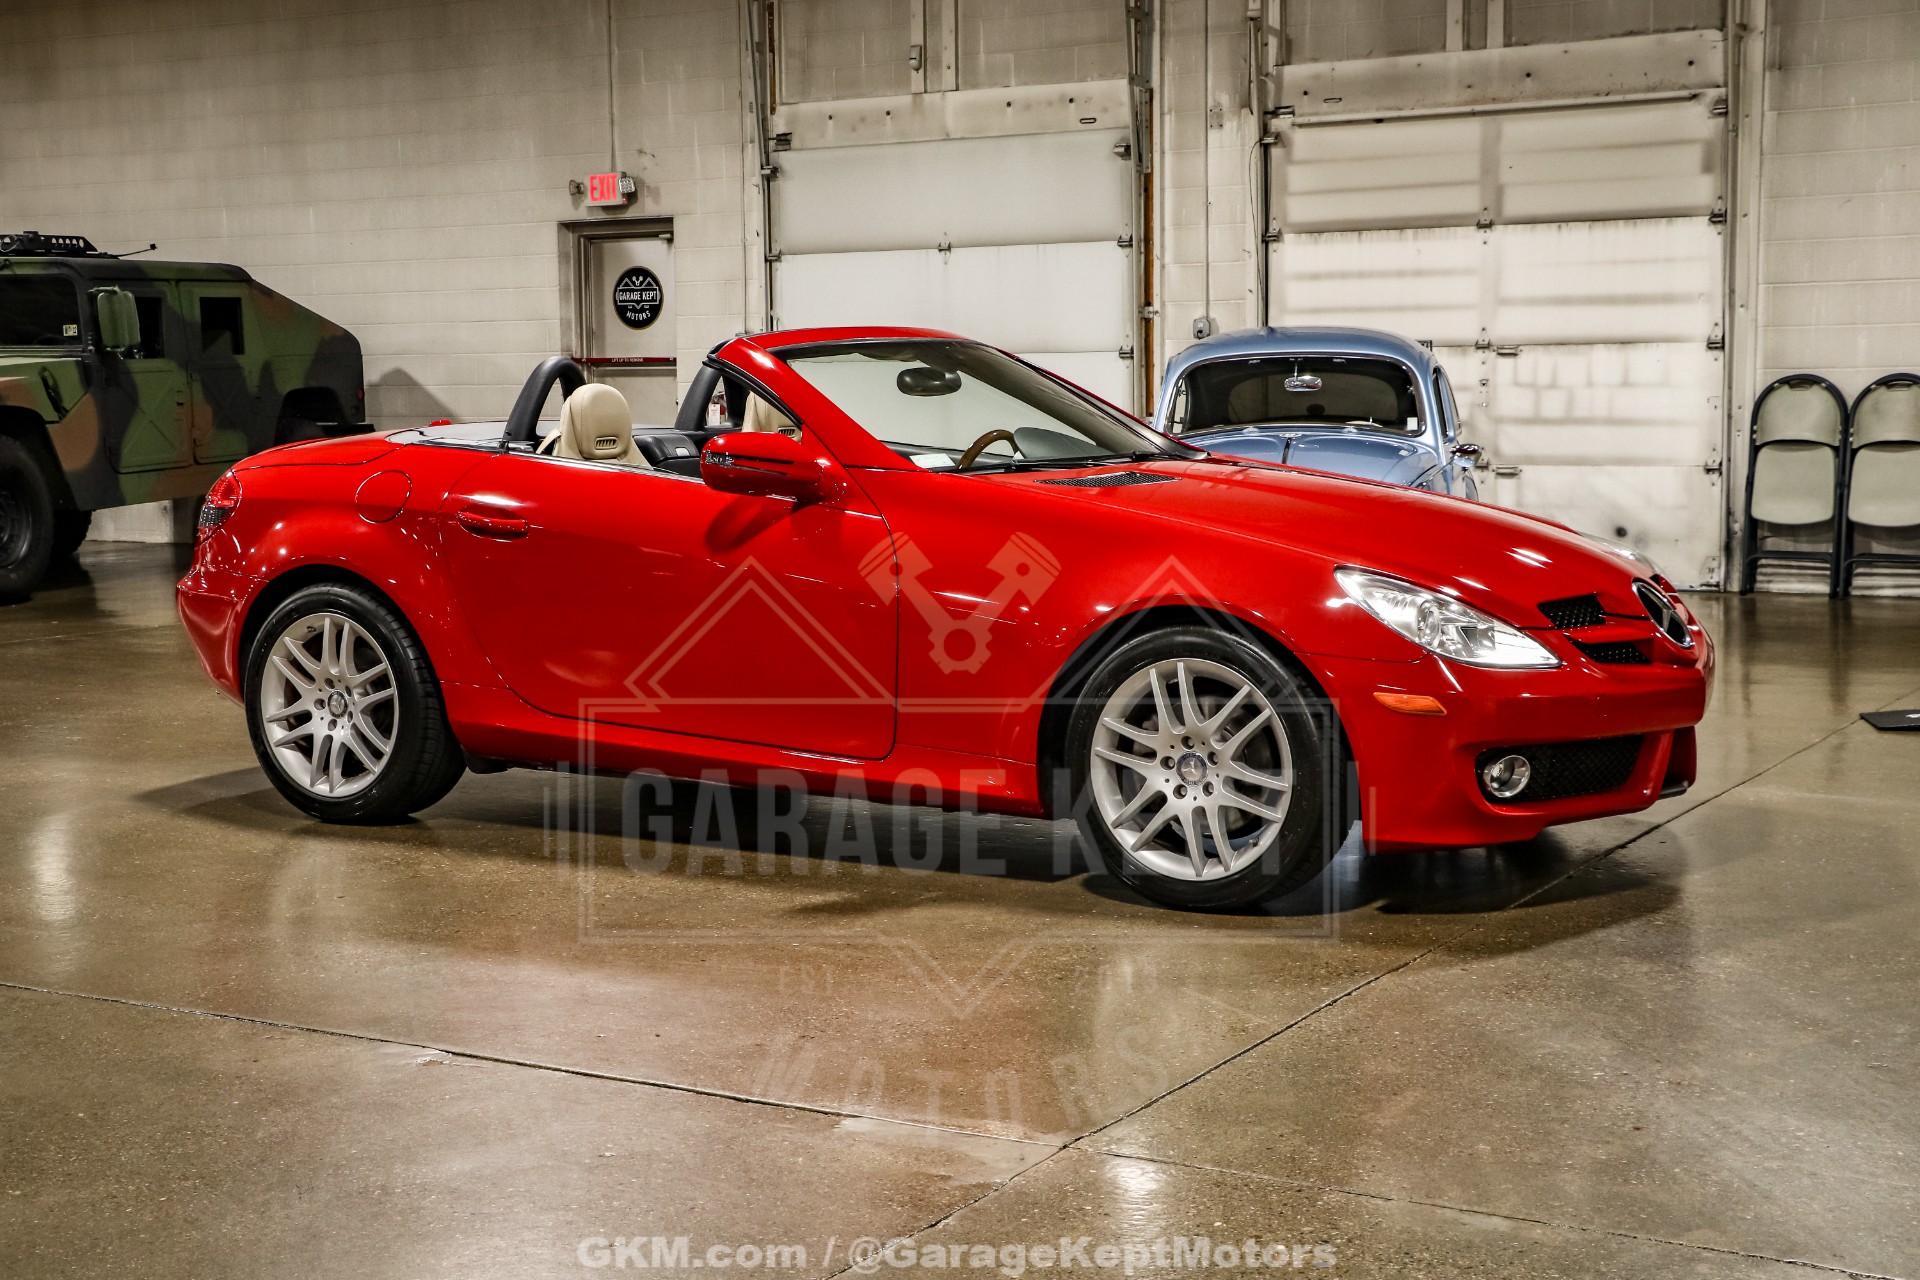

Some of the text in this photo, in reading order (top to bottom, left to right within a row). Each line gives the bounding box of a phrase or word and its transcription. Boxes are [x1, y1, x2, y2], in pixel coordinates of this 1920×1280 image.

[590, 174, 617, 201] EXIT
[619, 291, 657, 301] GARAGE KEPT
[626, 310, 651, 321] MOTORS
